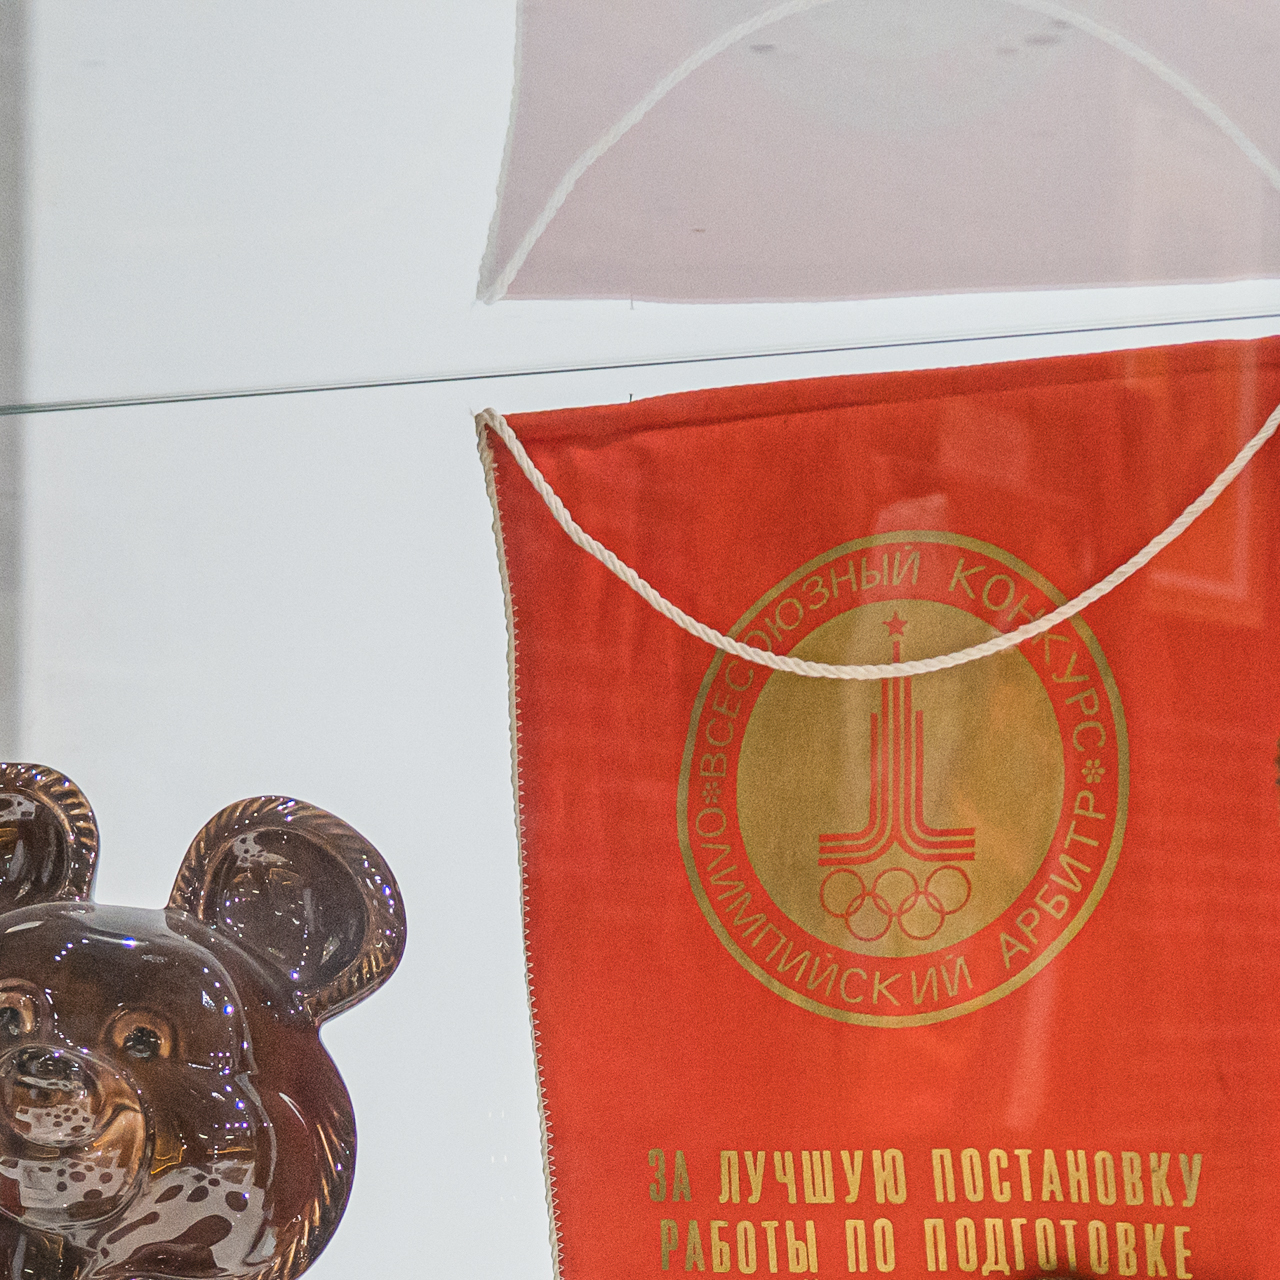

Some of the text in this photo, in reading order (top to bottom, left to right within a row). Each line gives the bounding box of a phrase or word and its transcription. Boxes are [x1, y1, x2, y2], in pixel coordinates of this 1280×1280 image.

[696, 789, 1106, 1005] ОЛИМПИЙСКИЙ АРБИТР
[648, 1148, 1204, 1208] ЗА ЛУЧШУЮ ПОСТАНОВКУ
[660, 1218, 1194, 1280] РАБОТЫ ПО ПОДГОТОВКЕ
